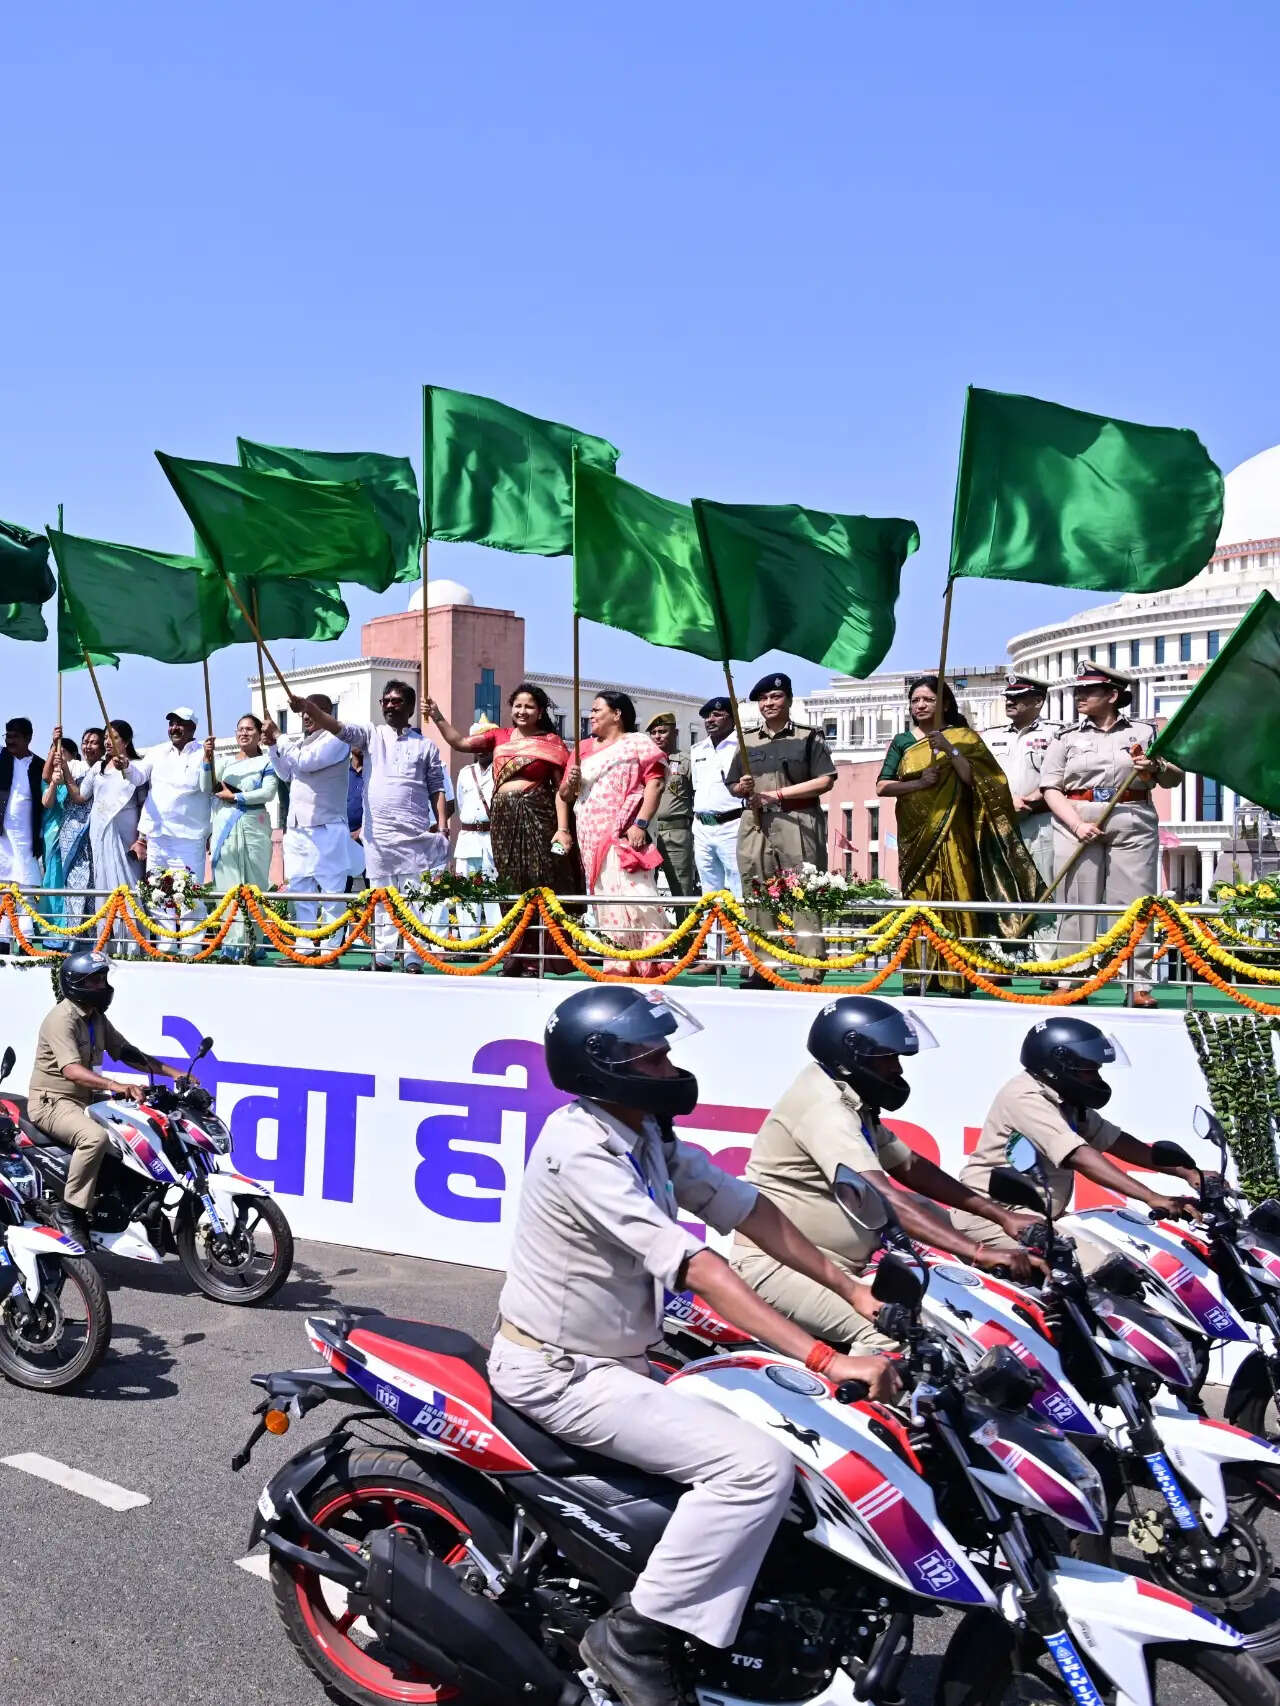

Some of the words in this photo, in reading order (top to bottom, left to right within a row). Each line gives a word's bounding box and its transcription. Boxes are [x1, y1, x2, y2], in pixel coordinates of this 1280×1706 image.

[665, 1300, 728, 1335] POLICE
[1208, 1309, 1229, 1329] 112
[379, 1389, 398, 1410] 112
[1049, 1394, 1072, 1421] 112
[412, 1411, 493, 1453] POLICE
[537, 1494, 632, 1552] Apache
[920, 1555, 952, 1587] 112
[731, 1653, 763, 1669] TVS
